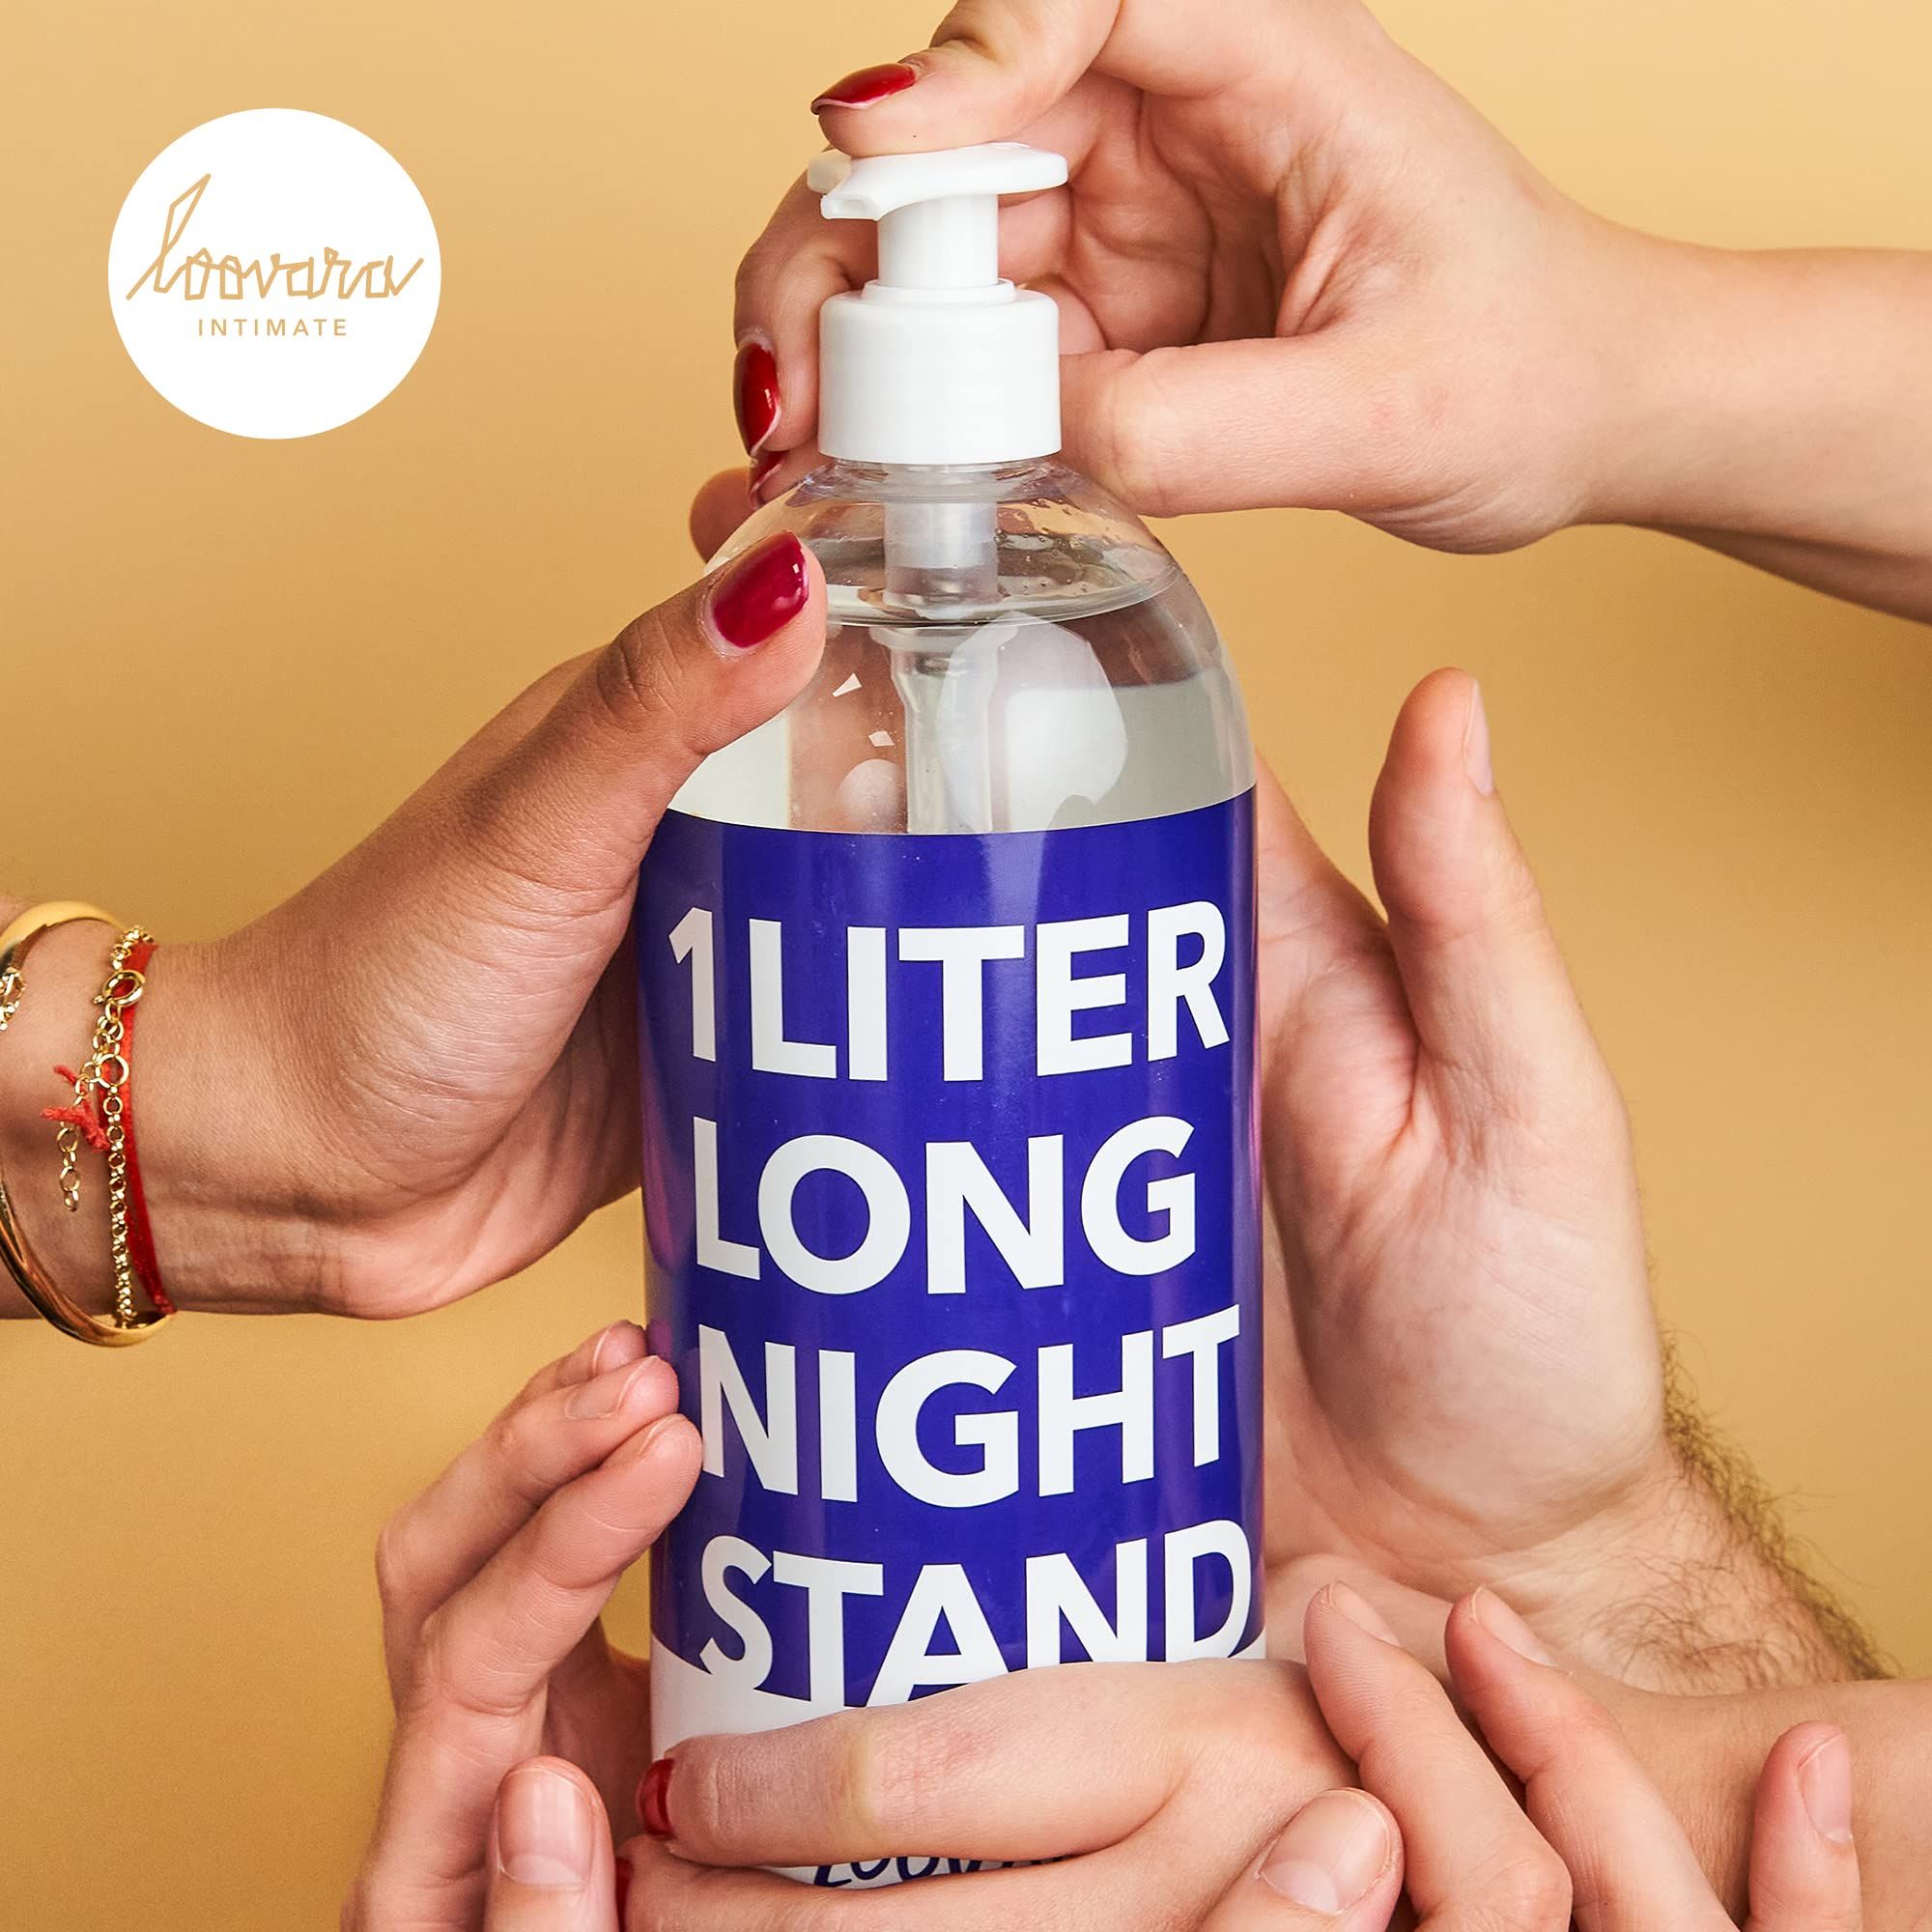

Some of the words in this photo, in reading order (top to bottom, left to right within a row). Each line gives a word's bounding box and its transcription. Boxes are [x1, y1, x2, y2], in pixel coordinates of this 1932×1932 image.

[668, 906, 717, 1063] 1
[749, 900, 1231, 1082] LITER
[693, 1115, 1196, 1295] LONG
[698, 1303, 1240, 1509] NIGHT
[699, 1520, 1252, 1708] STAND
